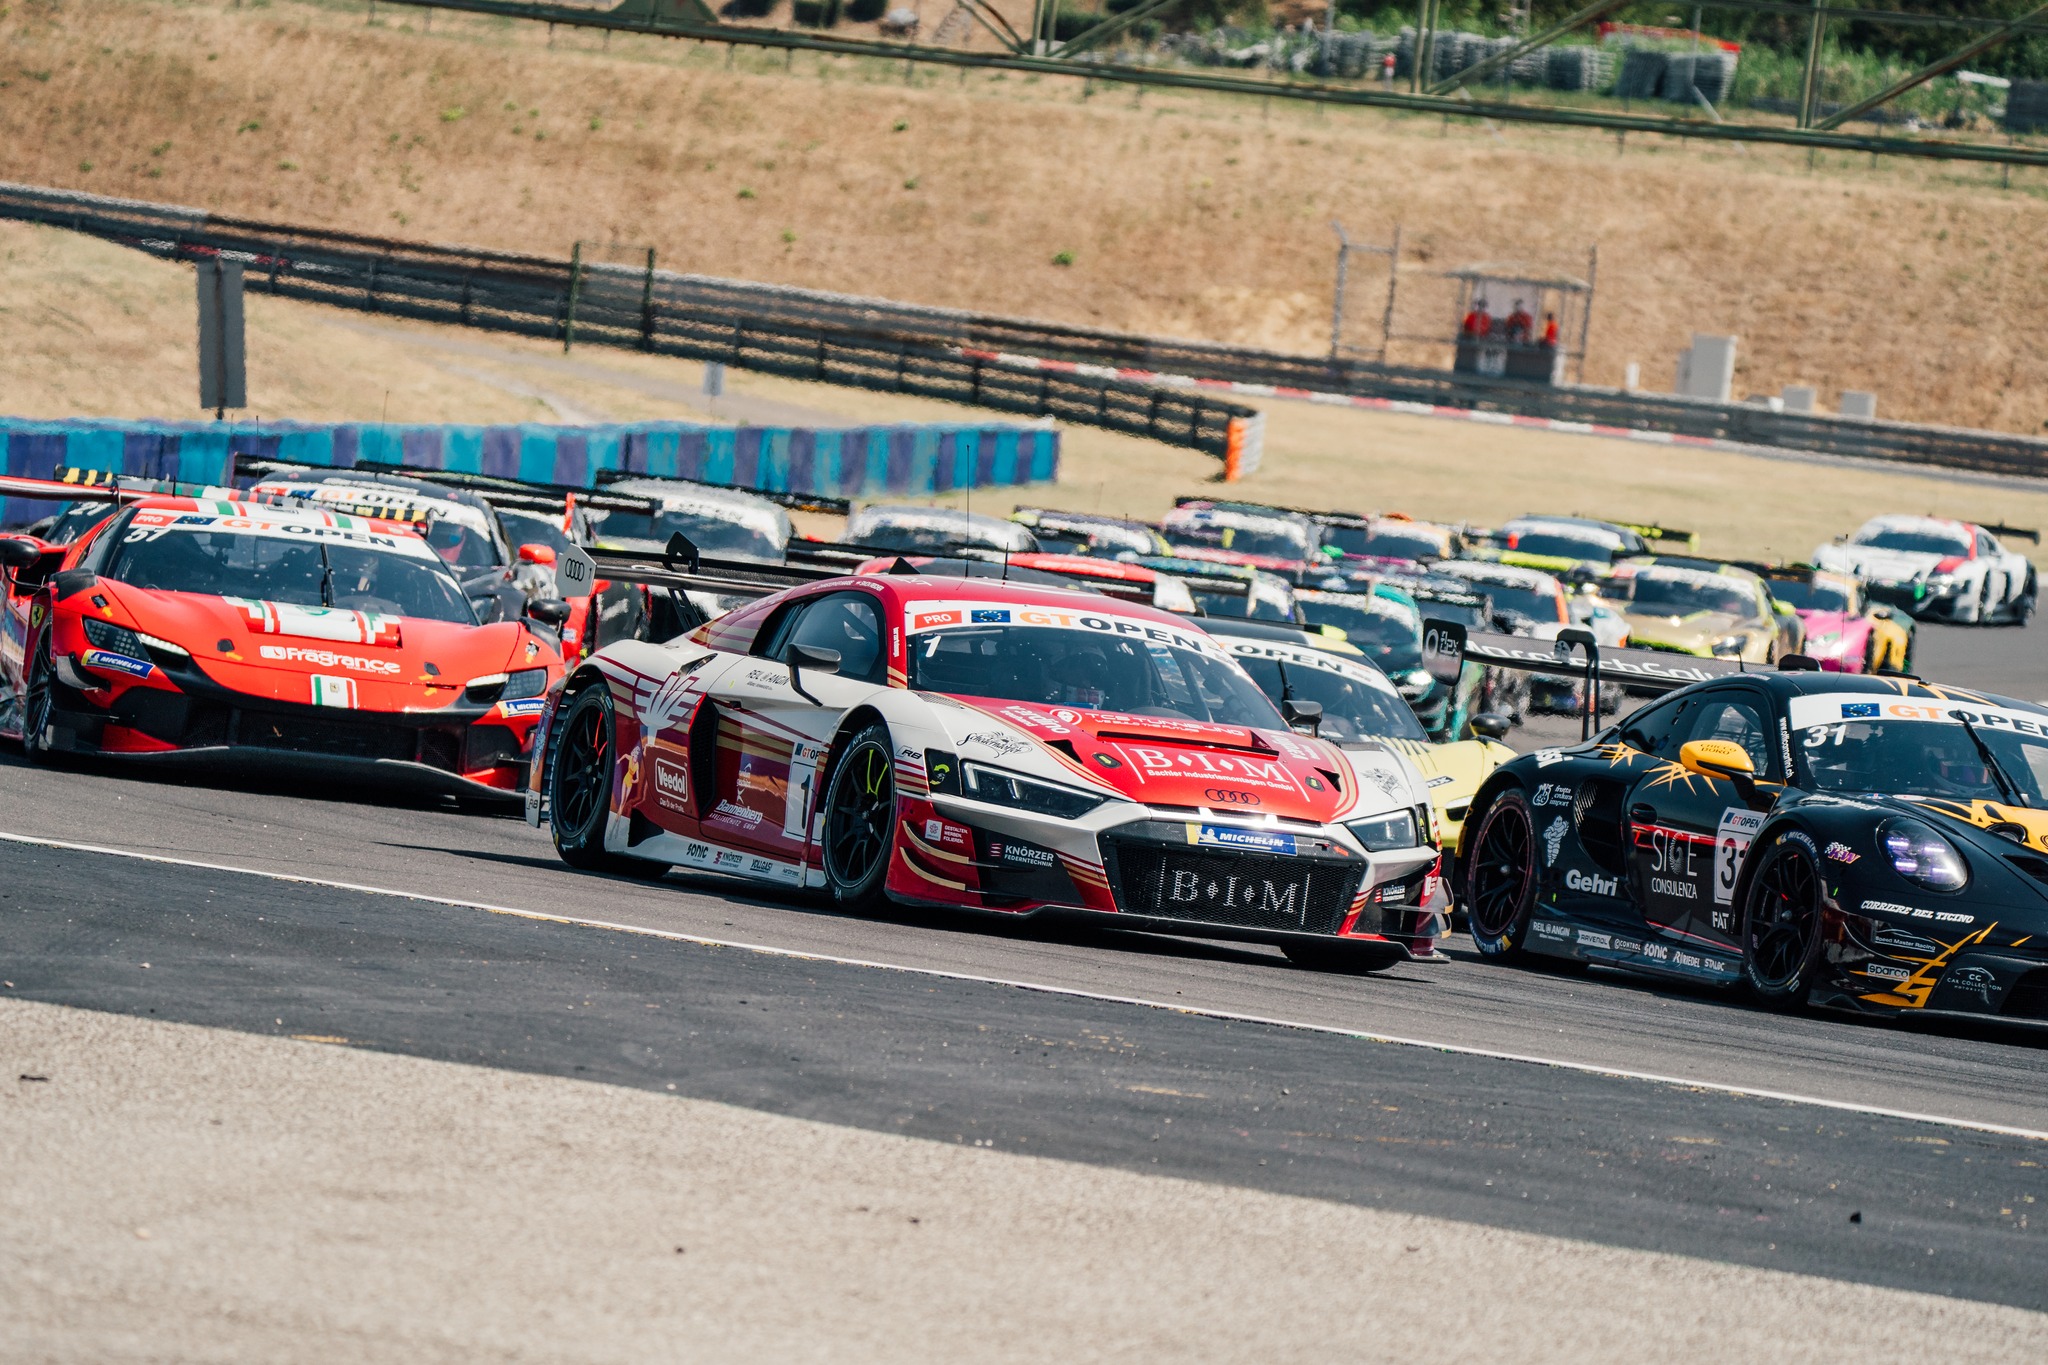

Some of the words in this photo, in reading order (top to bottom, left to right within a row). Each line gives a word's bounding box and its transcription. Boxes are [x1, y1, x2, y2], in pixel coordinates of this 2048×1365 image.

[136, 514, 164, 524] PRO
[124, 528, 170, 543] 51
[922, 613, 952, 624] PRO
[924, 636, 941, 658] 1
[100, 656, 144, 671] MICHELIN
[286, 647, 401, 674] Fragrance
[1132, 717, 1245, 737] TUNNELING
[1888, 704, 2048, 738] GTOPE
[1803, 724, 1847, 748] 31
[902, 748, 922, 760] R8
[658, 766, 686, 794] Veedol
[1146, 769, 1182, 778] Bachler
[1268, 780, 1295, 792] GmbH
[800, 774, 810, 830] 1
[716, 798, 763, 824] Bannenberg
[1220, 832, 1284, 847] MICHELIN
[1788, 832, 1817, 854] MICHELIN
[722, 852, 743, 864] KNÖRZER
[1004, 854, 1053, 868] FEDERNTECHNIK
[1005, 844, 1054, 862] KNÖRZER
[1566, 868, 1618, 896] Gehri
[1652, 877, 1698, 900] CONSULENZA
[1860, 900, 1913, 915] CORRIERE
[1912, 908, 1934, 919] DEL
[1935, 911, 1975, 924] TICINO
[1532, 921, 1546, 932] REIL
[1551, 925, 1571, 937] ANGIN
[1580, 934, 1608, 945] RAVENOL
[1875, 936, 1892, 944] Speed
[1893, 938, 1914, 946] Master
[1915, 942, 1936, 951] Racing
[1868, 964, 1909, 978] sparco
[1968, 973, 1982, 982] CC
[1961, 980, 2002, 991] COLLECON
